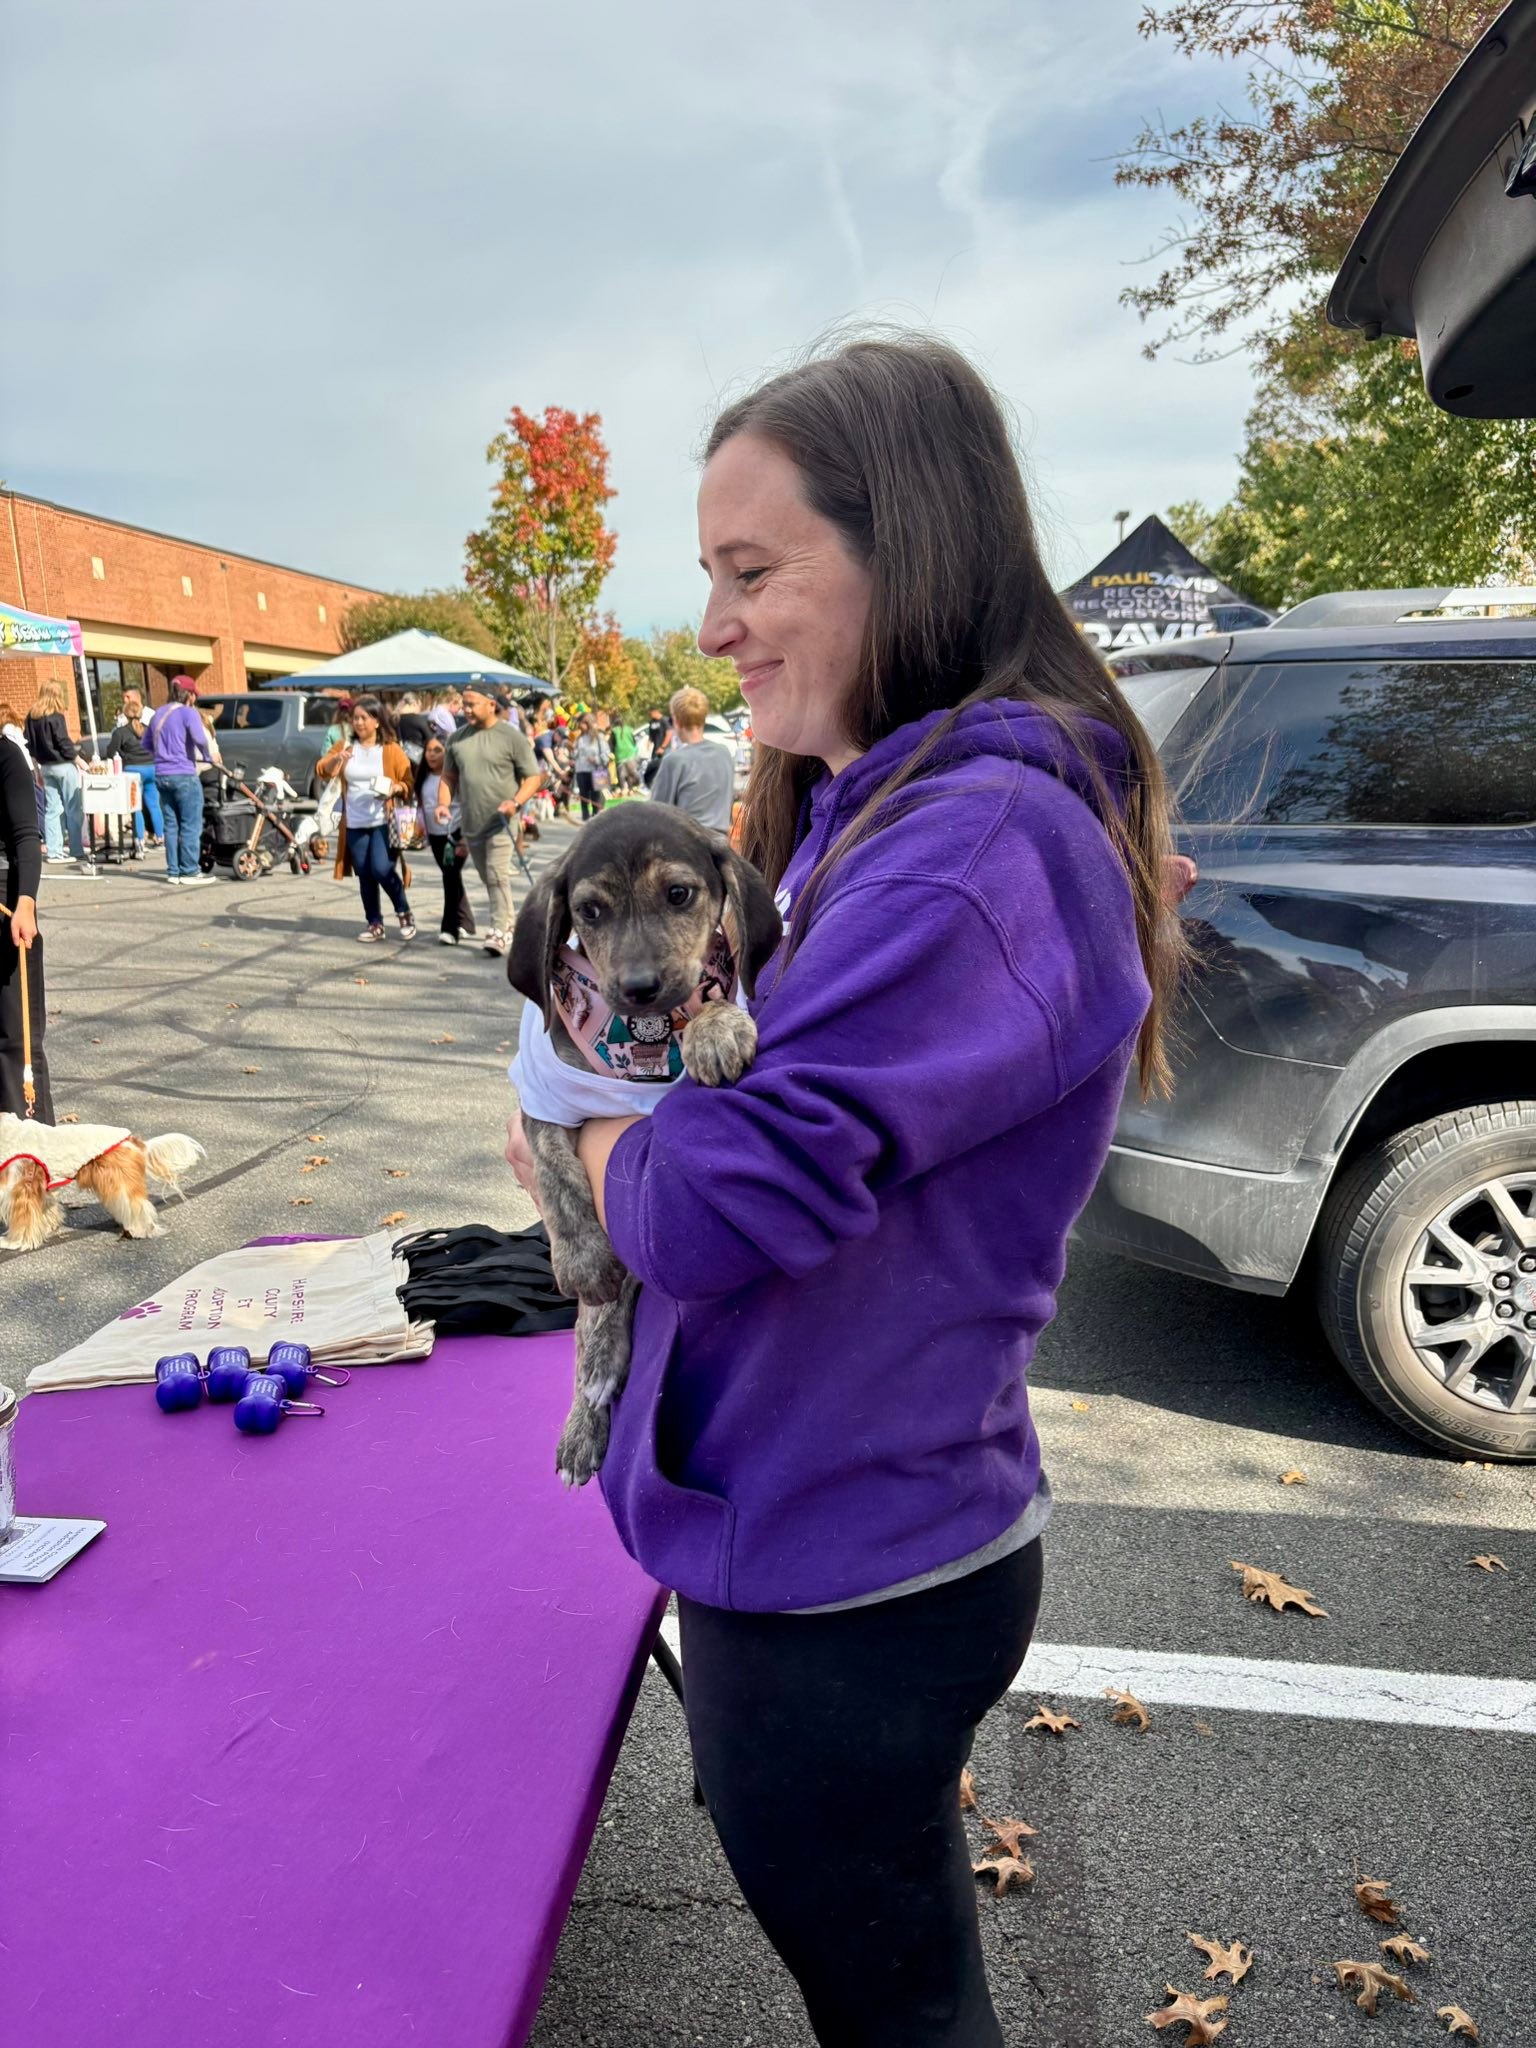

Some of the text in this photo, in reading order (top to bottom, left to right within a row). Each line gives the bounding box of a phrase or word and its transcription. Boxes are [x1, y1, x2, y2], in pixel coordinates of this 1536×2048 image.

[1103, 586, 1207, 603] RECOVER
[1106, 609, 1210, 622] RESTORE
[1428, 1408, 1511, 1445] 235/65R18
